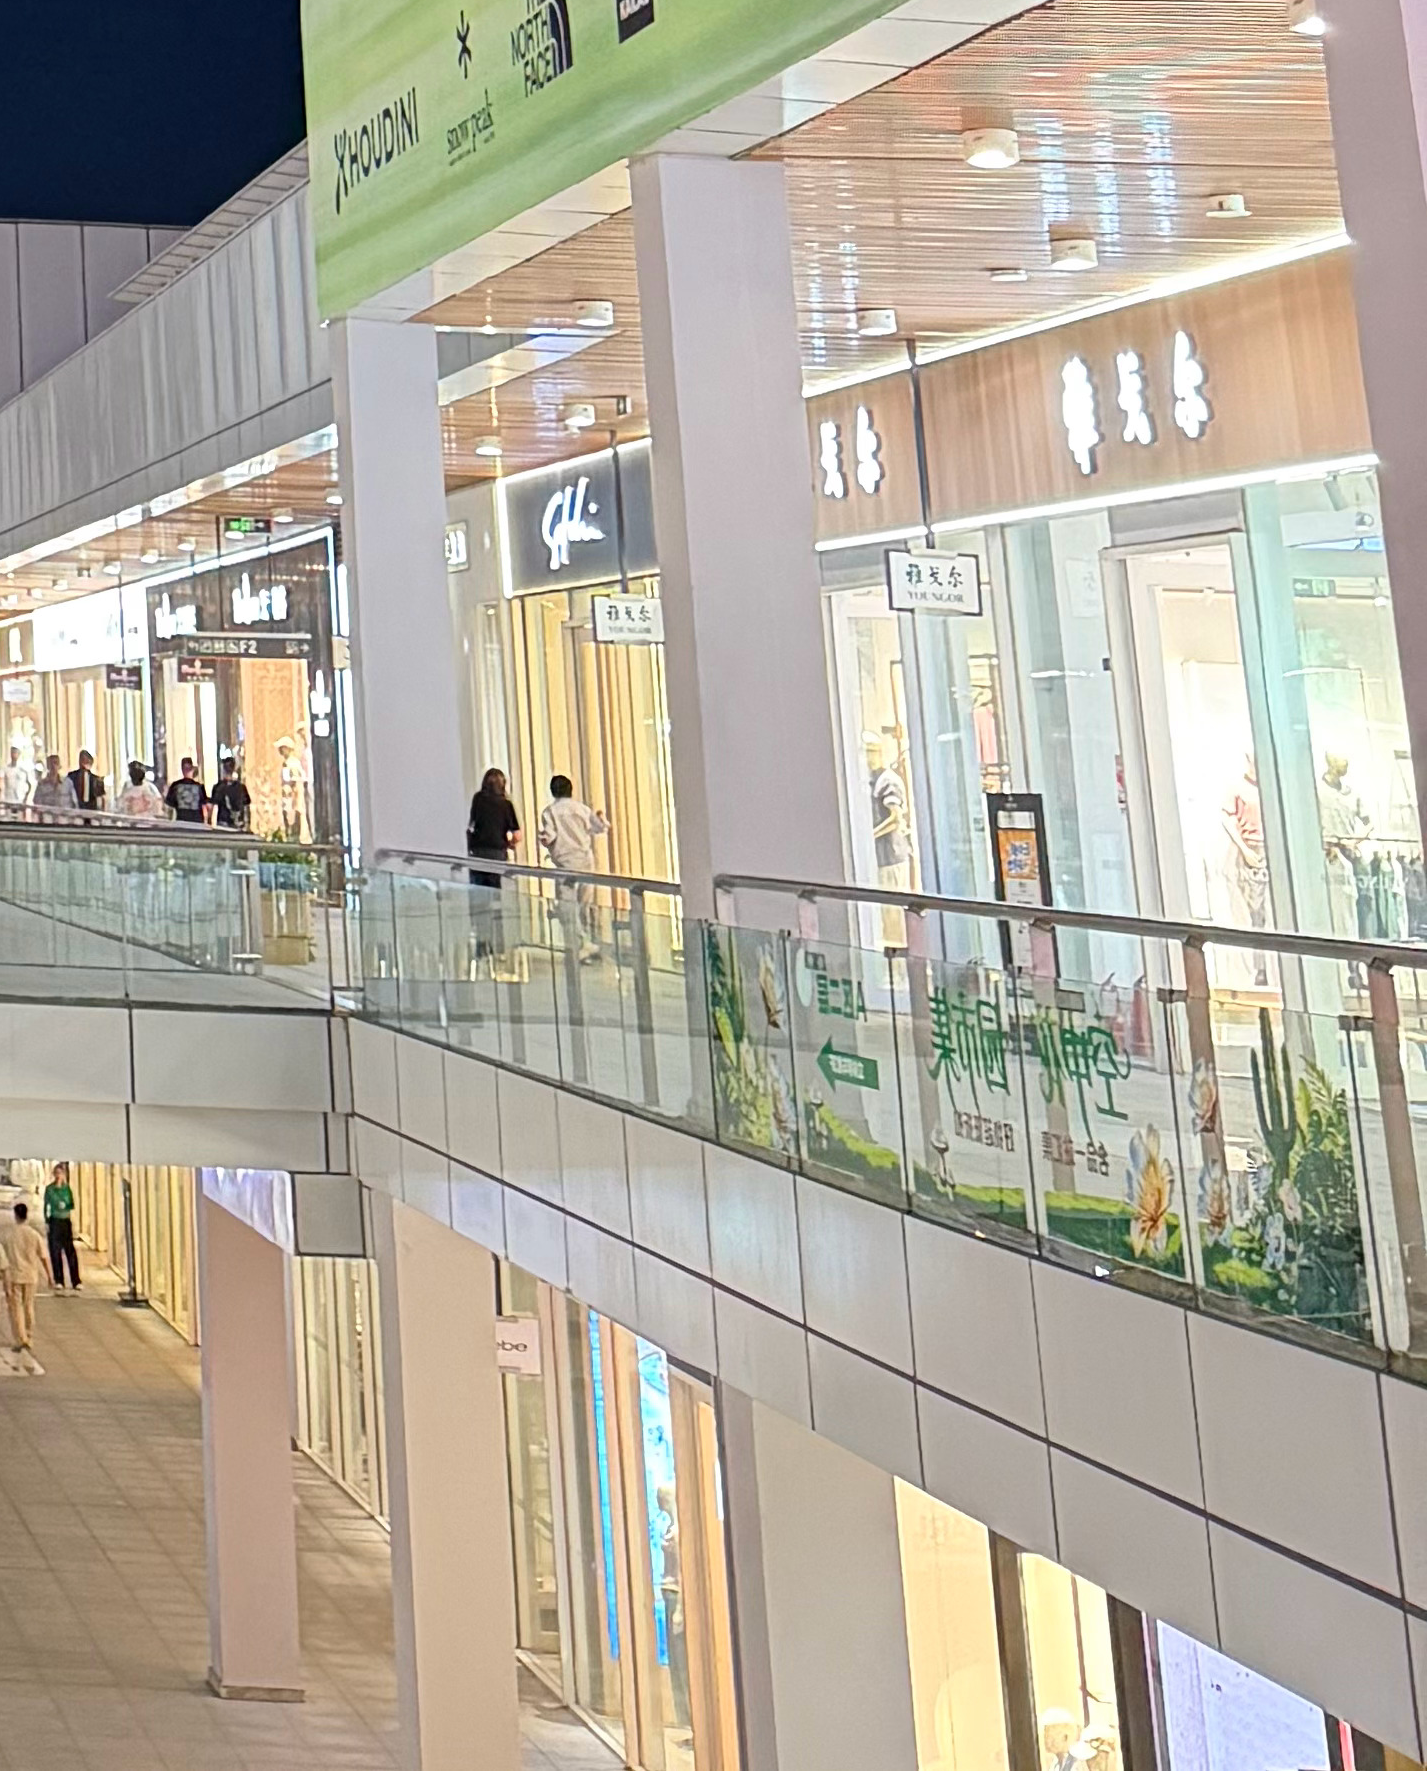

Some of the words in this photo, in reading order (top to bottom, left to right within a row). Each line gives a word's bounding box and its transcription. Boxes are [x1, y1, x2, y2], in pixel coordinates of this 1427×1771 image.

[510, 9, 550, 67] NORTH
[523, 44, 553, 99] FACE
[347, 86, 420, 190] HOUDINI
[239, 639, 258, 655] F2
